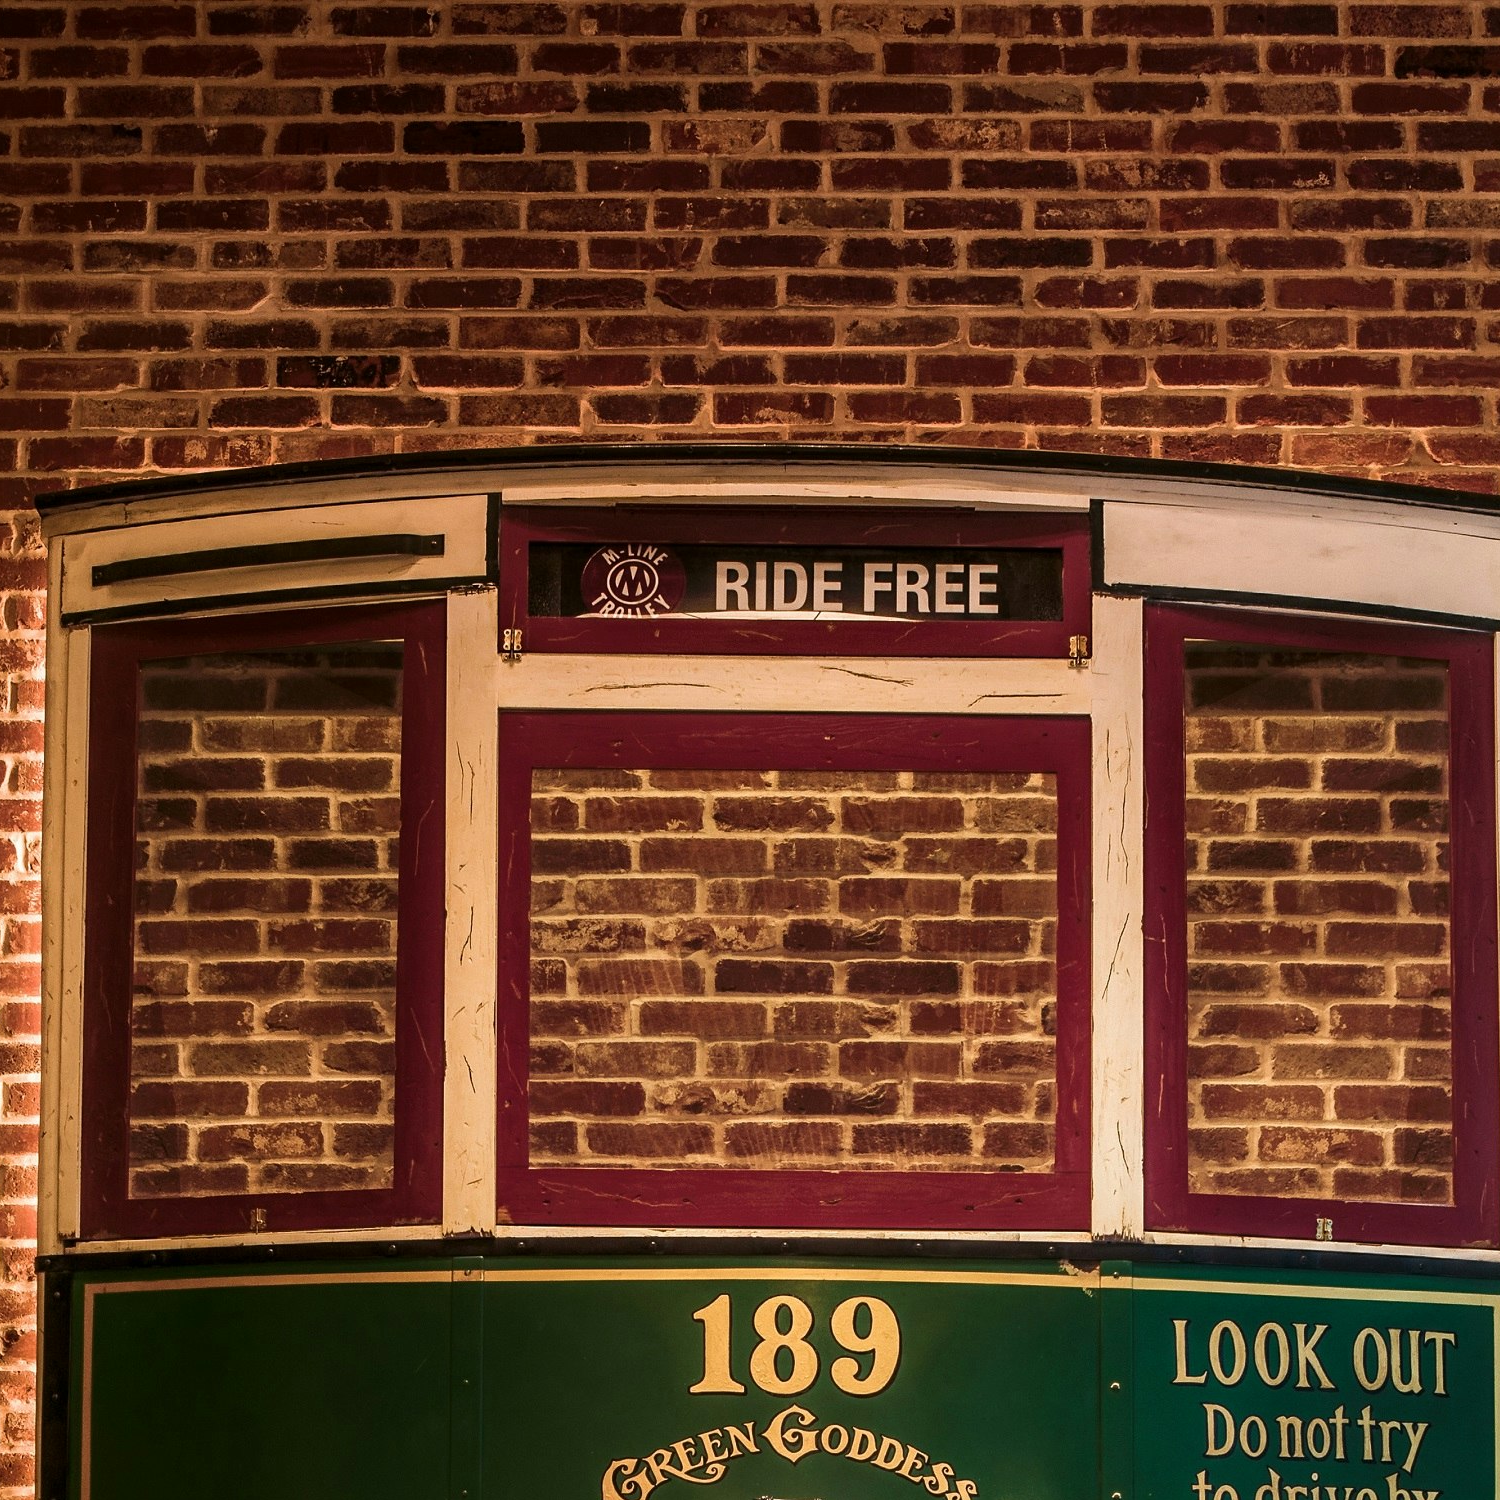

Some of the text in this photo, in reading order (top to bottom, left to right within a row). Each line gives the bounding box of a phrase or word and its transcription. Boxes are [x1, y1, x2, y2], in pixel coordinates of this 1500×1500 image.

[601, 543, 668, 566] M-LINE
[591, 592, 670, 619] TROLLEY
[714, 561, 999, 615] RIDE FREE
[689, 1293, 901, 1397] 189
[1171, 1319, 1457, 1396] LOOK OUT
[1202, 1402, 1430, 1473] Do not try
